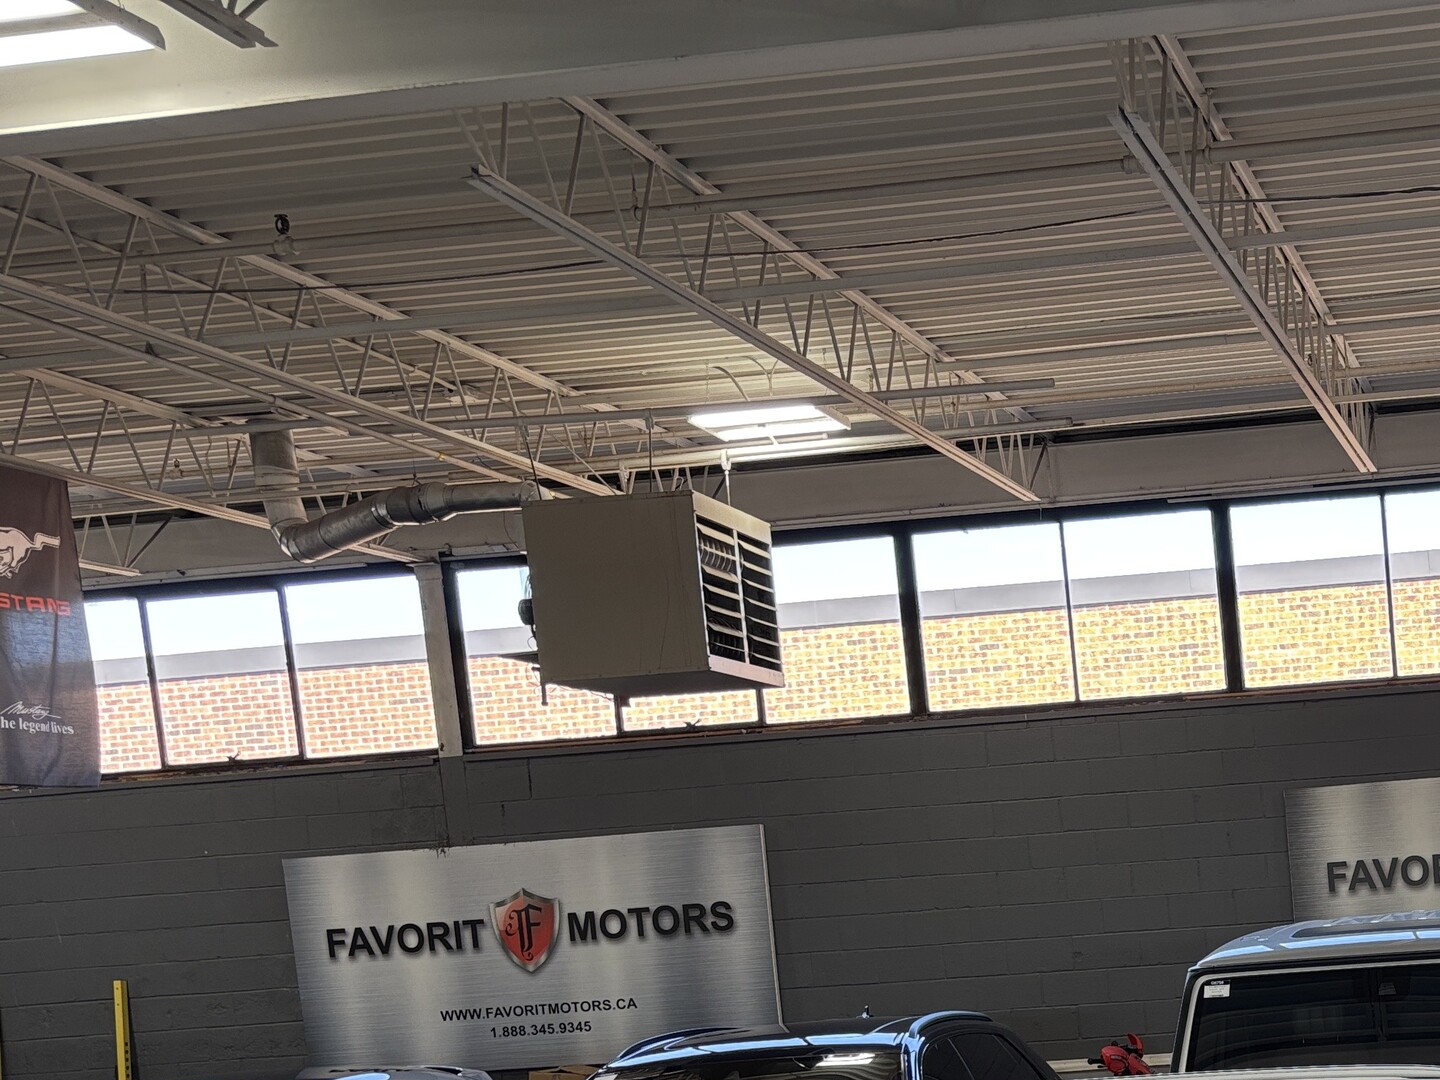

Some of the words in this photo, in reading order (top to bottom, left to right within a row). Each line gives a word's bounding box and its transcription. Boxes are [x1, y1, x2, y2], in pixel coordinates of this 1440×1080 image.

[0, 592, 71, 616] STANG
[0, 716, 16, 730] he
[18, 717, 50, 735] legend
[50, 721, 75, 735] lives
[326, 918, 485, 958] FAVORIT
[568, 901, 734, 943] MOTORS
[440, 997, 639, 1022] WWW.FAVORITMOTORS.CA
[490, 1020, 593, 1039] 1.888.345.9345
